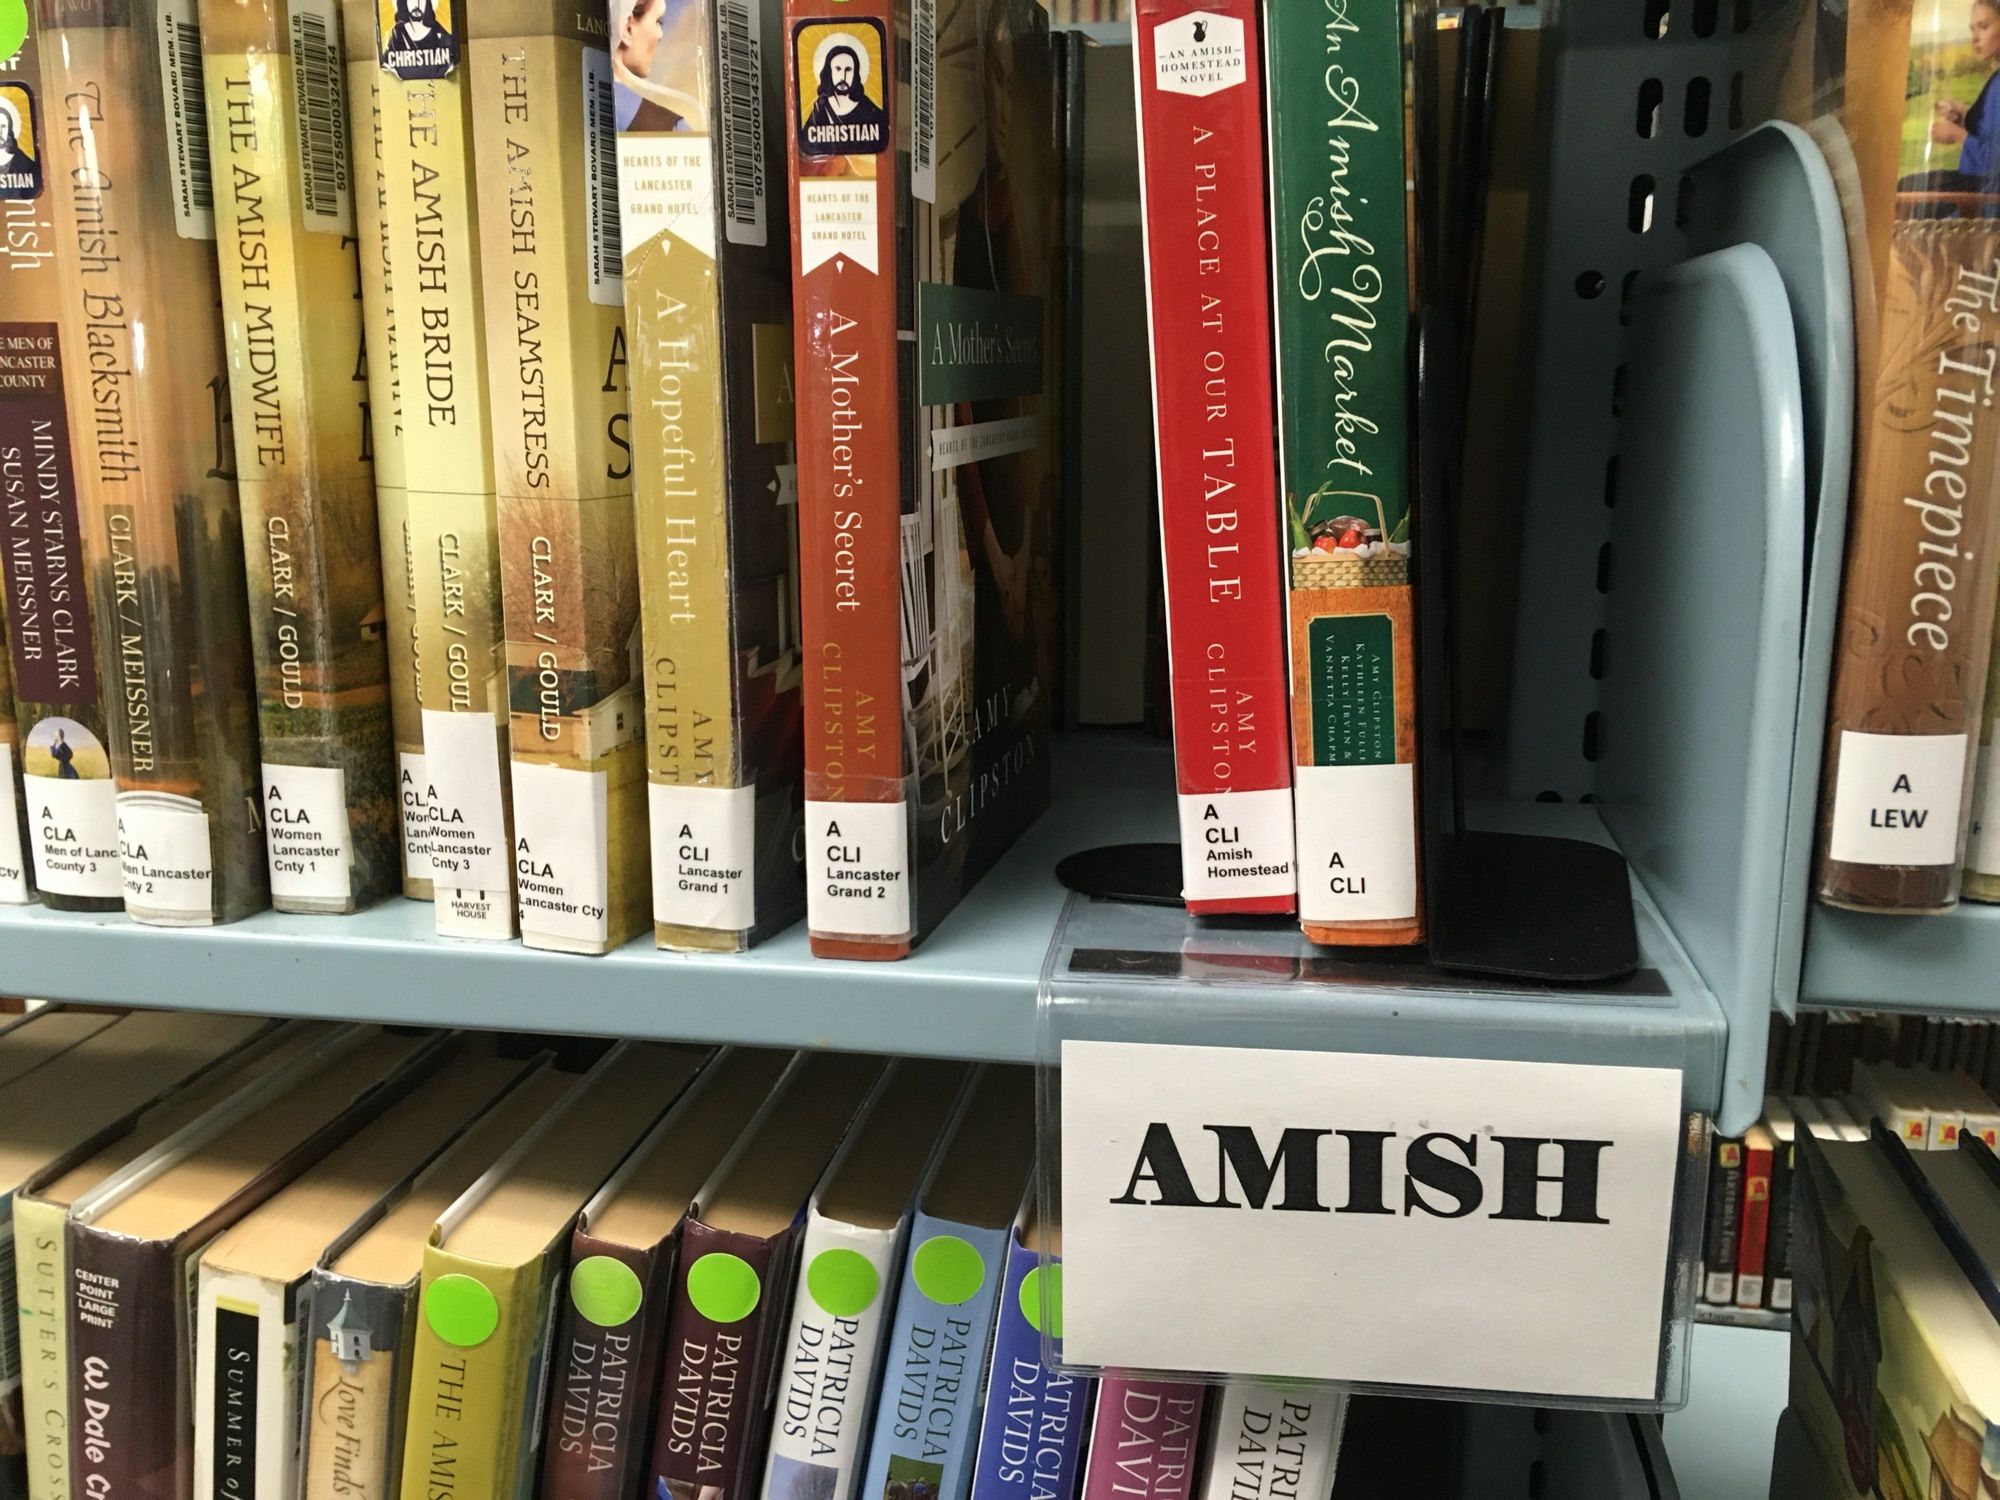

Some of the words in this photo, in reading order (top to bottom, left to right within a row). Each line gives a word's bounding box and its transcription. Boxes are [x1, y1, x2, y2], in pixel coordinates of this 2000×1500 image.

[294, 35, 304, 66] MEM.
[387, 47, 450, 67] CHRISTIAN
[720, 28, 729, 60] MEM.
[1191, 46, 1233, 58] AMISH
[1161, 58, 1241, 73] HOMESTEAD
[1180, 73, 1223, 85] NOVEL
[170, 70, 180, 118] BOVARD
[295, 69, 307, 115] BOVARD
[502, 47, 529, 125] THE
[721, 63, 731, 114] BOVARD
[226, 77, 257, 153] THE
[807, 124, 880, 143] CHRISTIAN
[175, 121, 187, 176] STEWART
[299, 116, 310, 170] STEWART
[722, 116, 733, 174] STEWART
[1193, 125, 1214, 145] A
[624, 155, 665, 168] HEARTS
[667, 155, 681, 168] OF
[684, 155, 702, 167] THE
[180, 179, 191, 217] SARAH
[304, 172, 314, 211] SARAH
[506, 137, 536, 255] AMISH
[634, 180, 693, 192] LANCASTER
[725, 177, 734, 219] SARAH
[807, 193, 838, 203] HEARTS
[1300, 64, 1379, 300] Amish
[233, 164, 270, 290] AMISH
[412, 159, 447, 293] AMISH
[630, 203, 663, 215] GRAND
[667, 203, 699, 215] HOTEL
[815, 212, 862, 222] LANCASTER
[1195, 162, 1220, 275] PLACE
[811, 231, 839, 241] GRAND
[840, 231, 867, 240] HOTEL
[656, 290, 688, 320] A
[1201, 293, 1225, 332] AT
[1945, 258, 2000, 334] The
[829, 308, 858, 336] A
[7, 337, 35, 350] MEN
[38, 337, 54, 350] OF
[931, 322, 943, 365] A
[245, 302, 286, 466] MIDWIFE
[421, 306, 456, 427] BRIDE
[514, 271, 549, 488] SEAMSTRESS
[1326, 264, 1382, 476] Market
[82, 288, 141, 484] Blacksmith
[1203, 351, 1227, 422] OUR
[652, 339, 697, 498] Hopeful
[830, 351, 863, 498] Mother's
[32, 419, 59, 503] MINDY
[2, 447, 29, 529] SUSAN
[1904, 349, 1996, 651] Timepiece
[1202, 438, 1242, 603] TABLE
[42, 510, 70, 603] STARNS
[109, 514, 138, 606] CLARK
[268, 516, 294, 599] CLARK
[439, 531, 465, 617] CLARK
[665, 515, 697, 624] Heart
[834, 511, 863, 612] Secret
[12, 536, 42, 661] MEISSNER
[531, 536, 556, 623] CLARK
[53, 608, 80, 689] CLARK
[277, 625, 303, 710] GOULD
[120, 633, 154, 773] MEISSNER
[537, 650, 560, 741] GOULD
[855, 690, 876, 759] AMY
[1236, 690, 1256, 754] AMY
[1343, 704, 1352, 744] IRVIN
[1372, 690, 1382, 759] CLIPSTON
[269, 785, 282, 801] A
[402, 769, 413, 784] A
[427, 784, 438, 799] A
[1891, 774, 1912, 793] A
[42, 806, 53, 820] A
[270, 808, 310, 825] CLA
[429, 806, 464, 823] CLA
[826, 821, 841, 837] A
[1204, 803, 1219, 820] A
[1870, 808, 1928, 828] LEW
[44, 826, 77, 843] CLA
[45, 844, 67, 857] Men
[70, 846, 82, 857] of
[271, 828, 322, 841] Women
[273, 844, 340, 857] Lancaster
[430, 826, 475, 840] Women
[431, 841, 491, 856] Lancaster
[518, 838, 530, 853] A
[679, 824, 693, 839] A
[1205, 827, 1239, 844] CLI
[46, 859, 85, 875] County
[90, 862, 97, 873] 3
[142, 865, 212, 880] Lancaster
[274, 860, 305, 874] Cnty
[432, 856, 459, 872] Cnty
[463, 859, 470, 871] 3
[518, 859, 555, 878] CLA
[678, 864, 743, 880] Lancaster
[679, 846, 709, 862] CLI
[826, 846, 861, 863] CLI
[1207, 847, 1252, 861] Amish
[1208, 862, 1289, 878] Homestead
[1329, 852, 1344, 869] A
[145, 882, 154, 894] 2
[518, 878, 564, 896] Women
[678, 880, 718, 895] Grand
[826, 867, 901, 882] Lancaster
[826, 884, 872, 899] Grand
[877, 885, 886, 899] 2
[1330, 877, 1366, 894] CLI
[451, 901, 491, 911] HARVEST
[456, 910, 487, 919] HOUSE
[518, 894, 579, 915] Lancaster
[581, 905, 604, 920] Cty
[1110, 1122, 1614, 1225] AMISH
[75, 1268, 120, 1288] CENTER
[79, 1283, 114, 1300] POINT
[36, 1237, 57, 1390] SUTTER'S
[78, 1299, 116, 1318] LARGE
[80, 1312, 113, 1329] PRINT
[83, 1356, 110, 1391] W.
[435, 1358, 467, 1421] THE
[783, 1320, 824, 1440] DAVIDS
[811, 1315, 860, 1457] PATRICIA
[894, 1323, 936, 1441] DAVIDS
[922, 1316, 972, 1459] PATRICIA
[227, 1347, 250, 1467] SUMMER
[319, 1375, 364, 1430] Love
[560, 1338, 596, 1454] DAVIDS
[587, 1331, 630, 1474] PATRICIA
[668, 1338, 708, 1456] DAVIDS
[697, 1331, 742, 1474] PATRICIA
[84, 1398, 112, 1463] Dale
[998, 1357, 1040, 1485] DAVIDS
[332, 1431, 364, 1496] Finds
